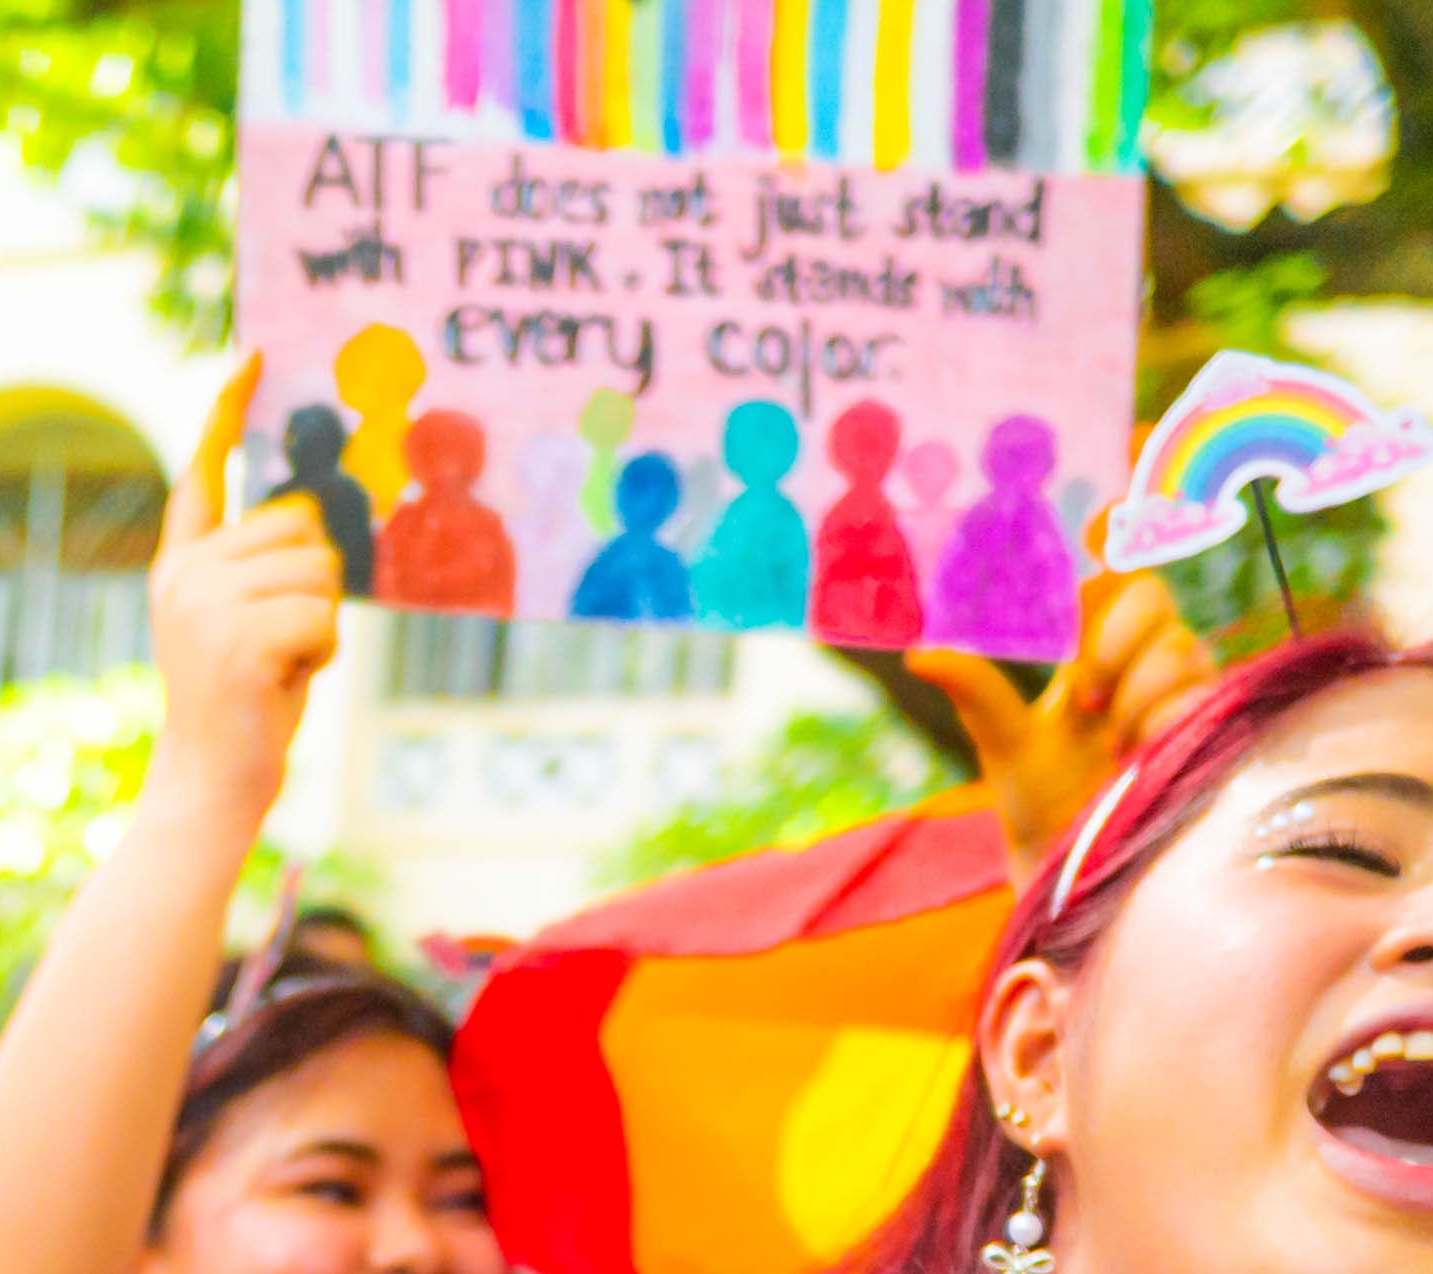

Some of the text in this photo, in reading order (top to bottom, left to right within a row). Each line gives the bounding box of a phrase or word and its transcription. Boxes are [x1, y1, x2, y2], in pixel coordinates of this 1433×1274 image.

[302, 132, 1045, 262] ATF does not just stand
[296, 216, 406, 290] with
[660, 238, 720, 297] It
[754, 253, 920, 310] stands
[938, 252, 1040, 322] with
[440, 303, 659, 399] every
